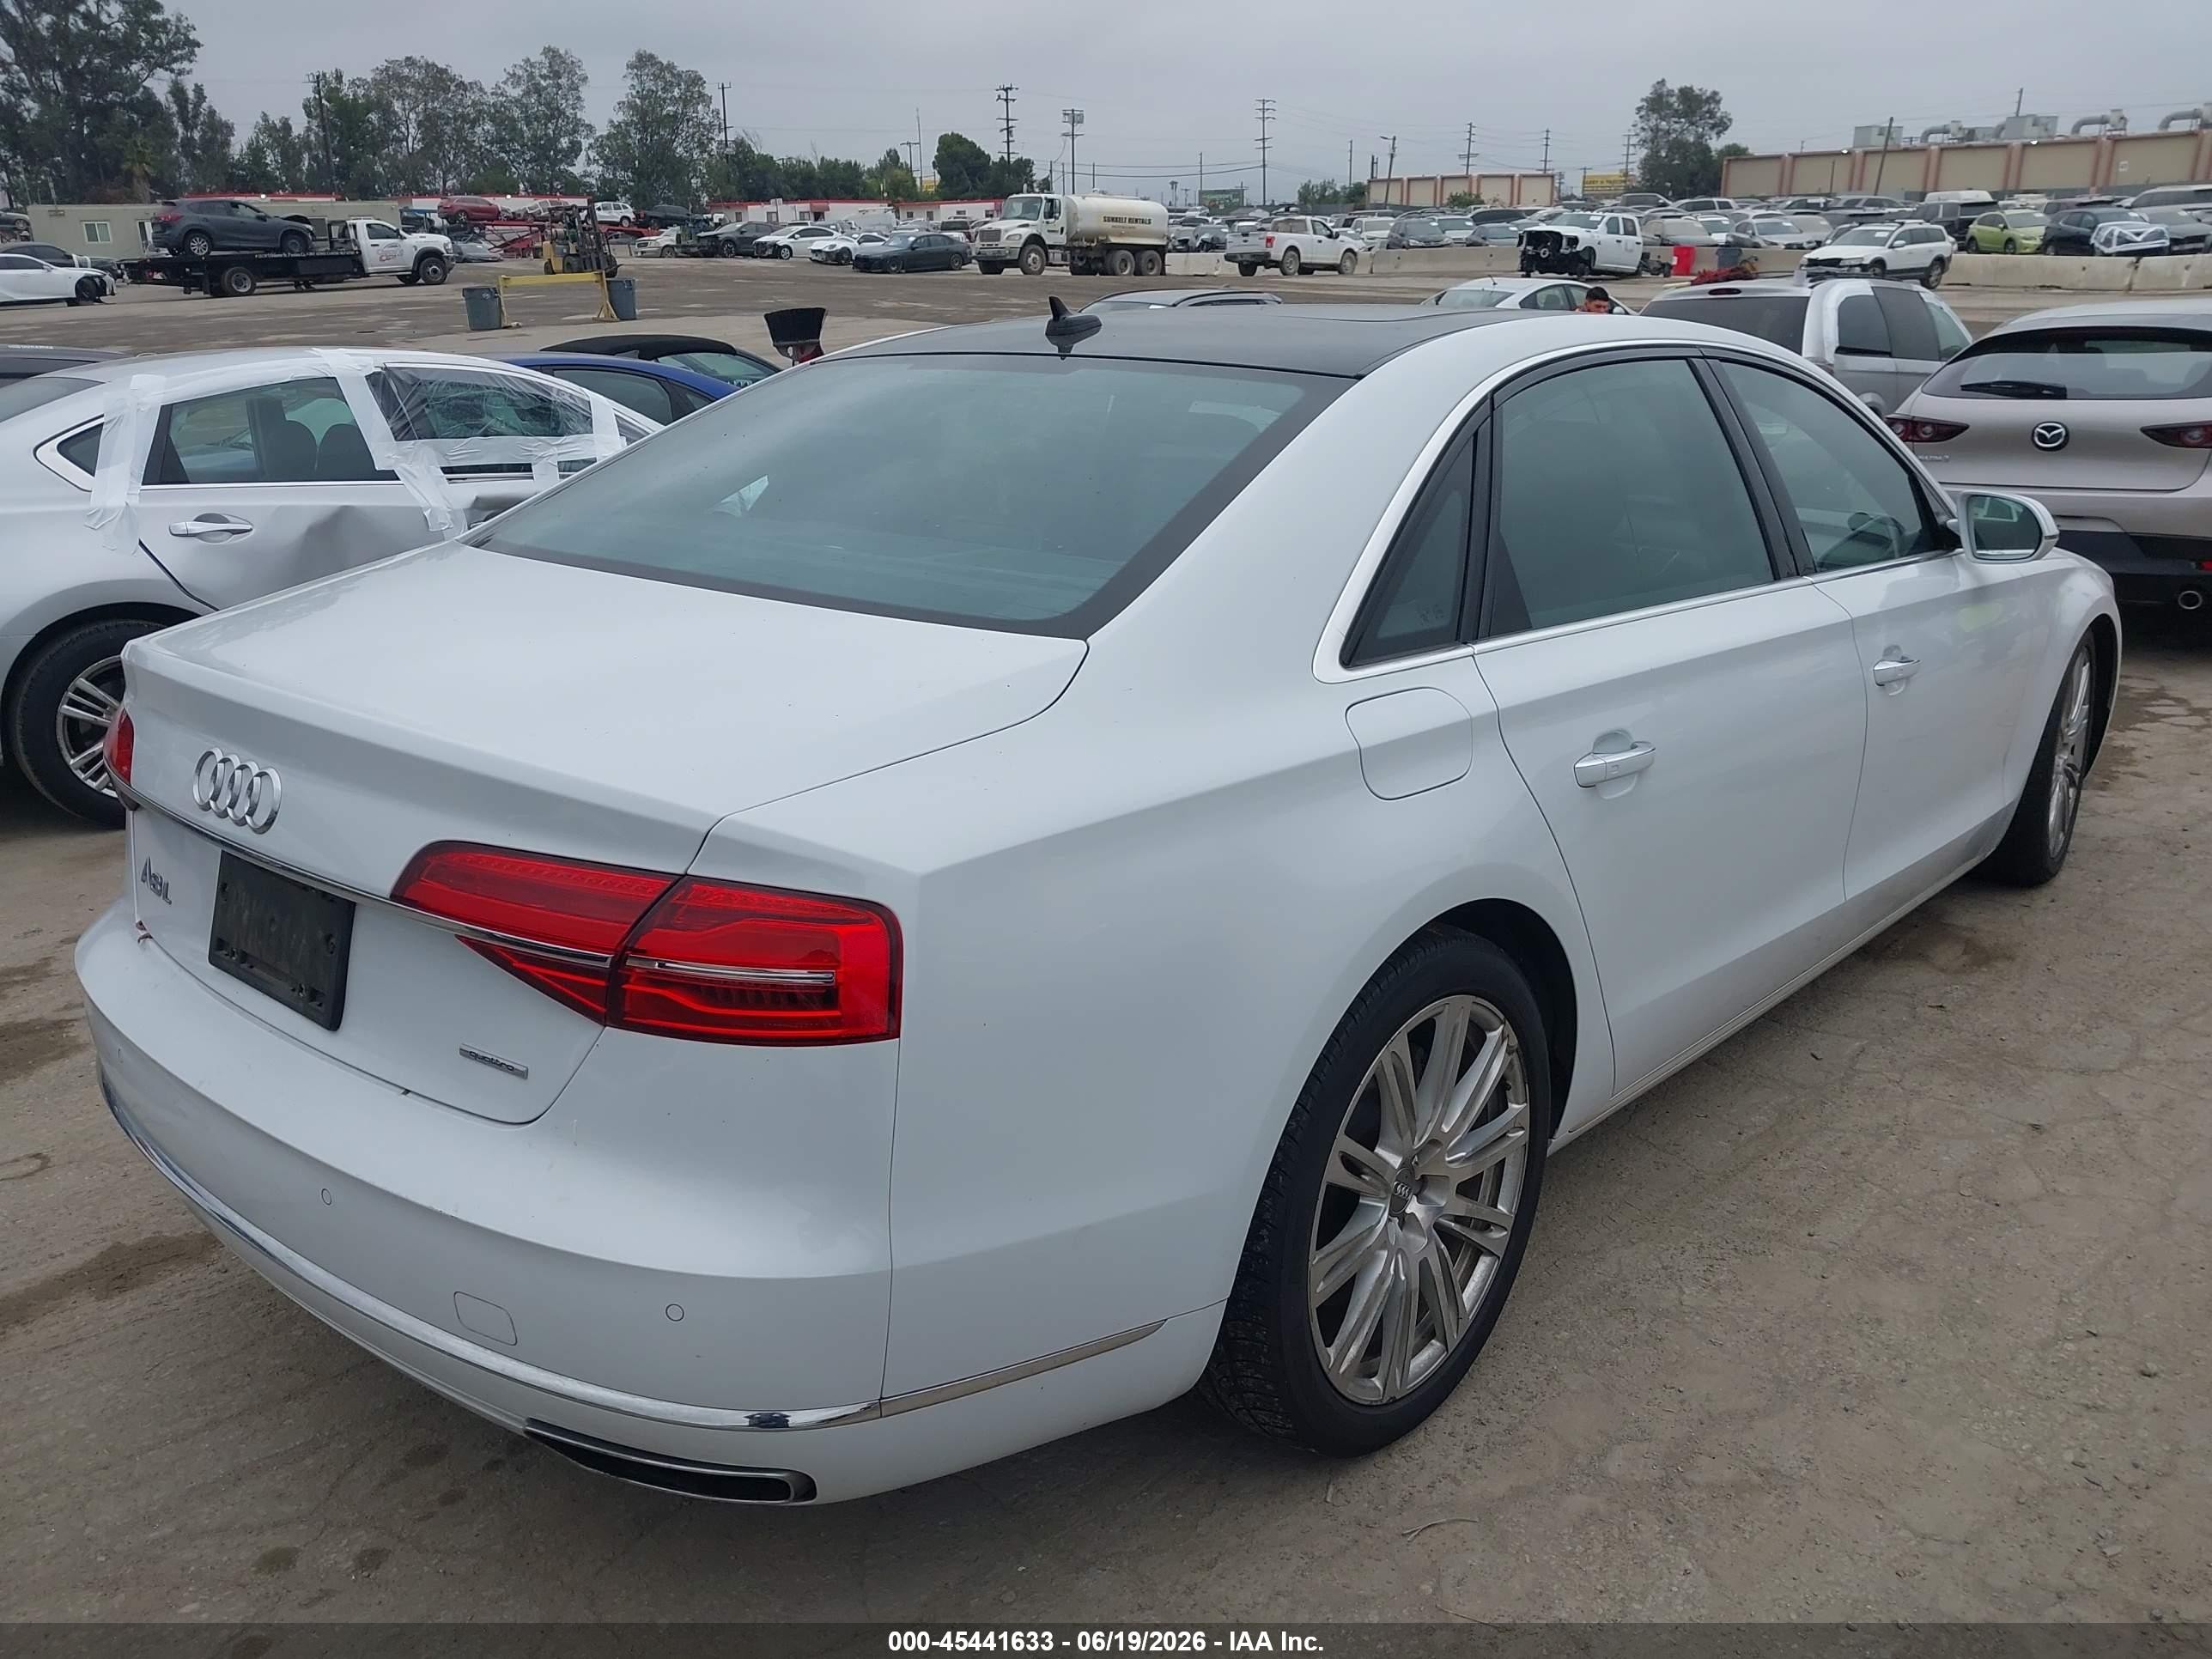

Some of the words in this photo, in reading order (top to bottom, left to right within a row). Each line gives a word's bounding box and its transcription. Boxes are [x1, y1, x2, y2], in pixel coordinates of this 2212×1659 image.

[1103, 216, 1127, 224] SUNBELT
[141, 855, 172, 906] A8L
[469, 1050, 515, 1072] quattro
